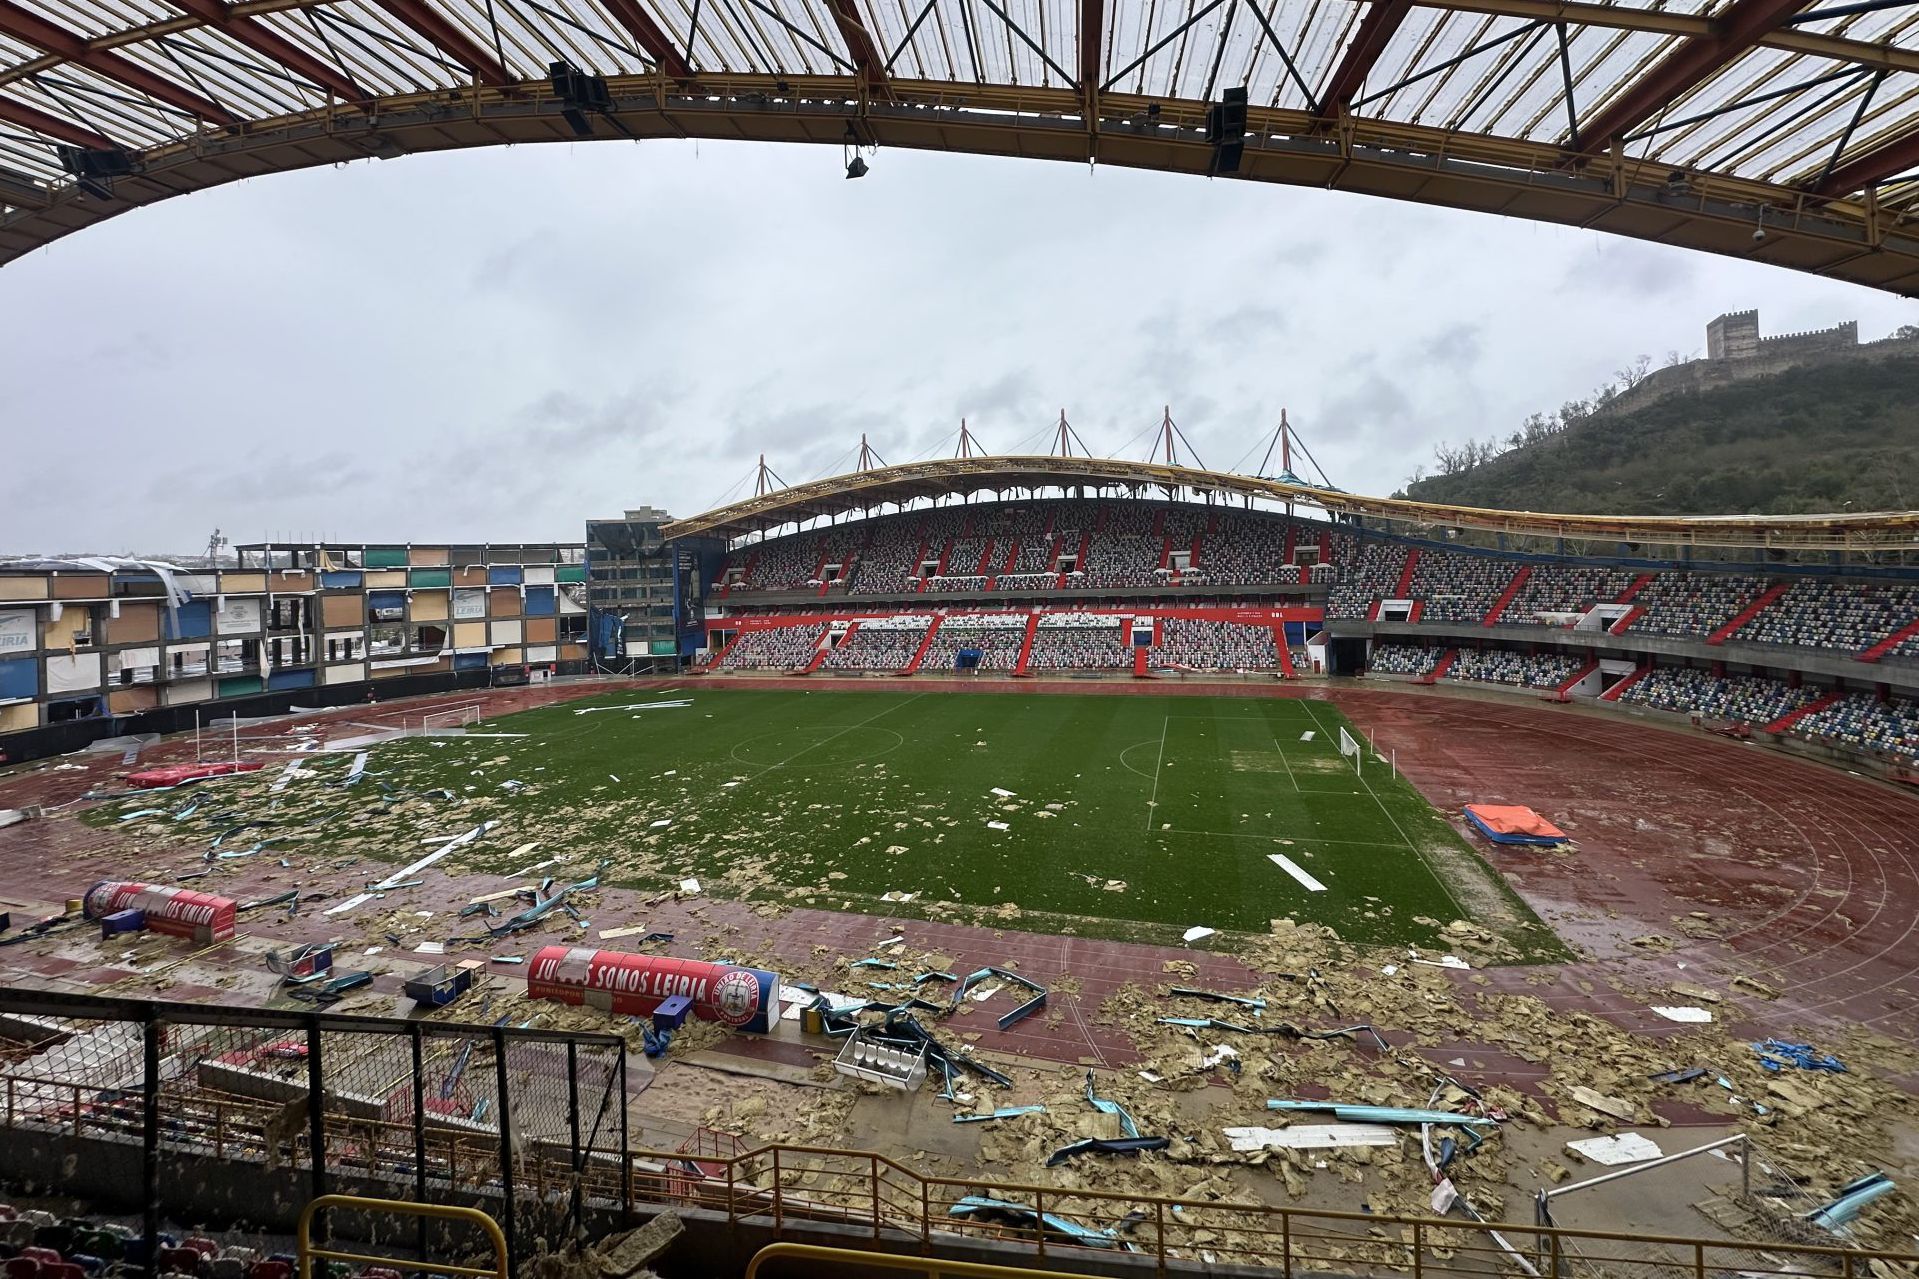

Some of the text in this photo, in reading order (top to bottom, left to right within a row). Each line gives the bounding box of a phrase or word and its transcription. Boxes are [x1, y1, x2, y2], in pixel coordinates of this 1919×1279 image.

[0, 636, 28, 647] IRIA
[595, 965, 650, 994] SOMOS
[653, 972, 707, 1001] LEIRIA
